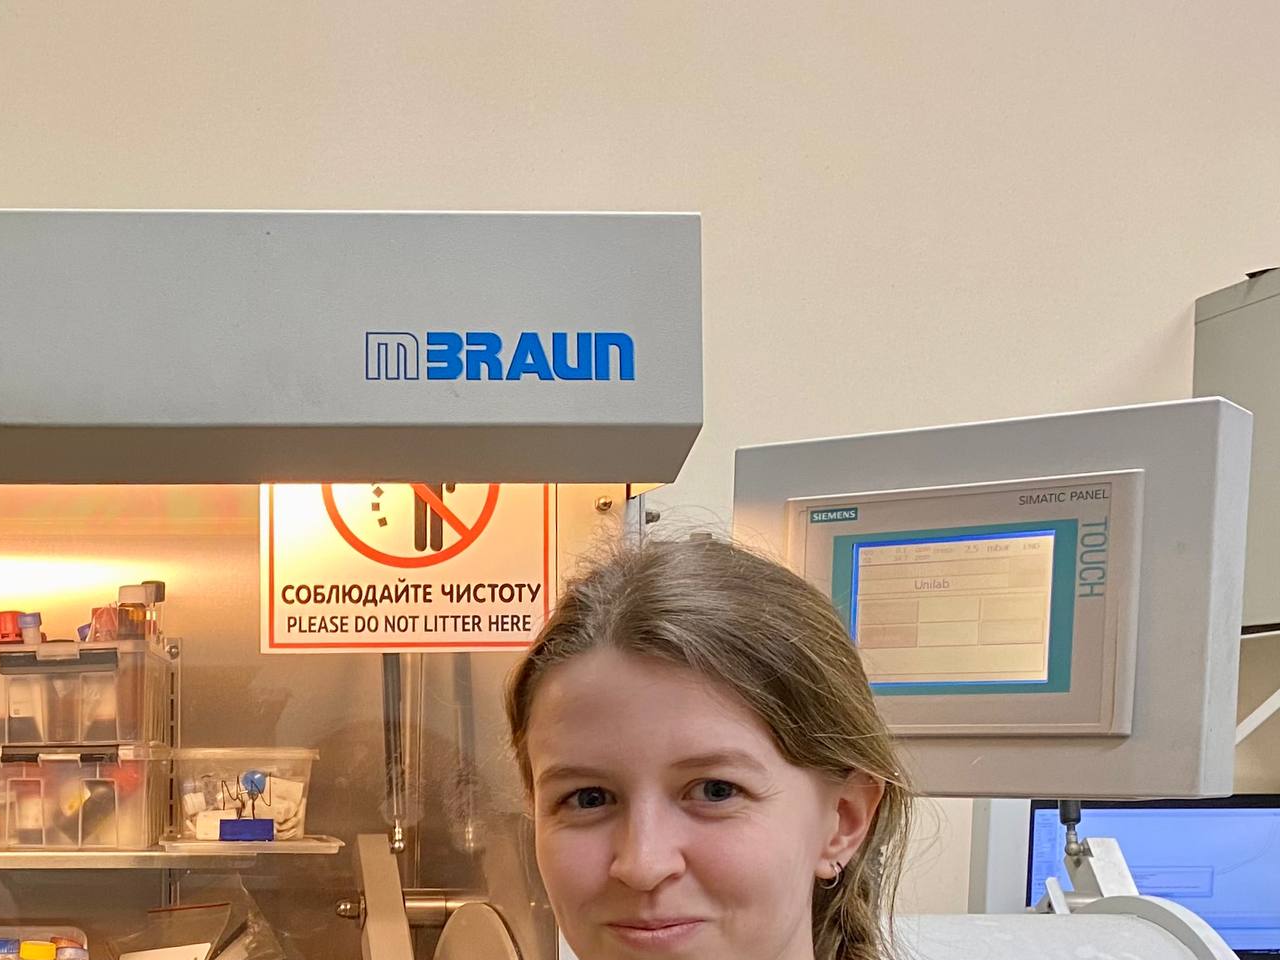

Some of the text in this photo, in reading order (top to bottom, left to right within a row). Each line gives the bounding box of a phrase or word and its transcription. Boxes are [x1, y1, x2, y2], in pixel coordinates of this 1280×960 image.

[1018, 488, 1110, 506] SIMATIC PANEL
[812, 510, 856, 521] SIEMENS
[1078, 515, 1108, 598] TOUCH
[281, 578, 542, 607] СОБЛЮДАЙТЕ ЧИСТОТУ
[914, 578, 950, 590] Unilab
[287, 615, 532, 633] PLEASE DO NOT LITTER HERE
